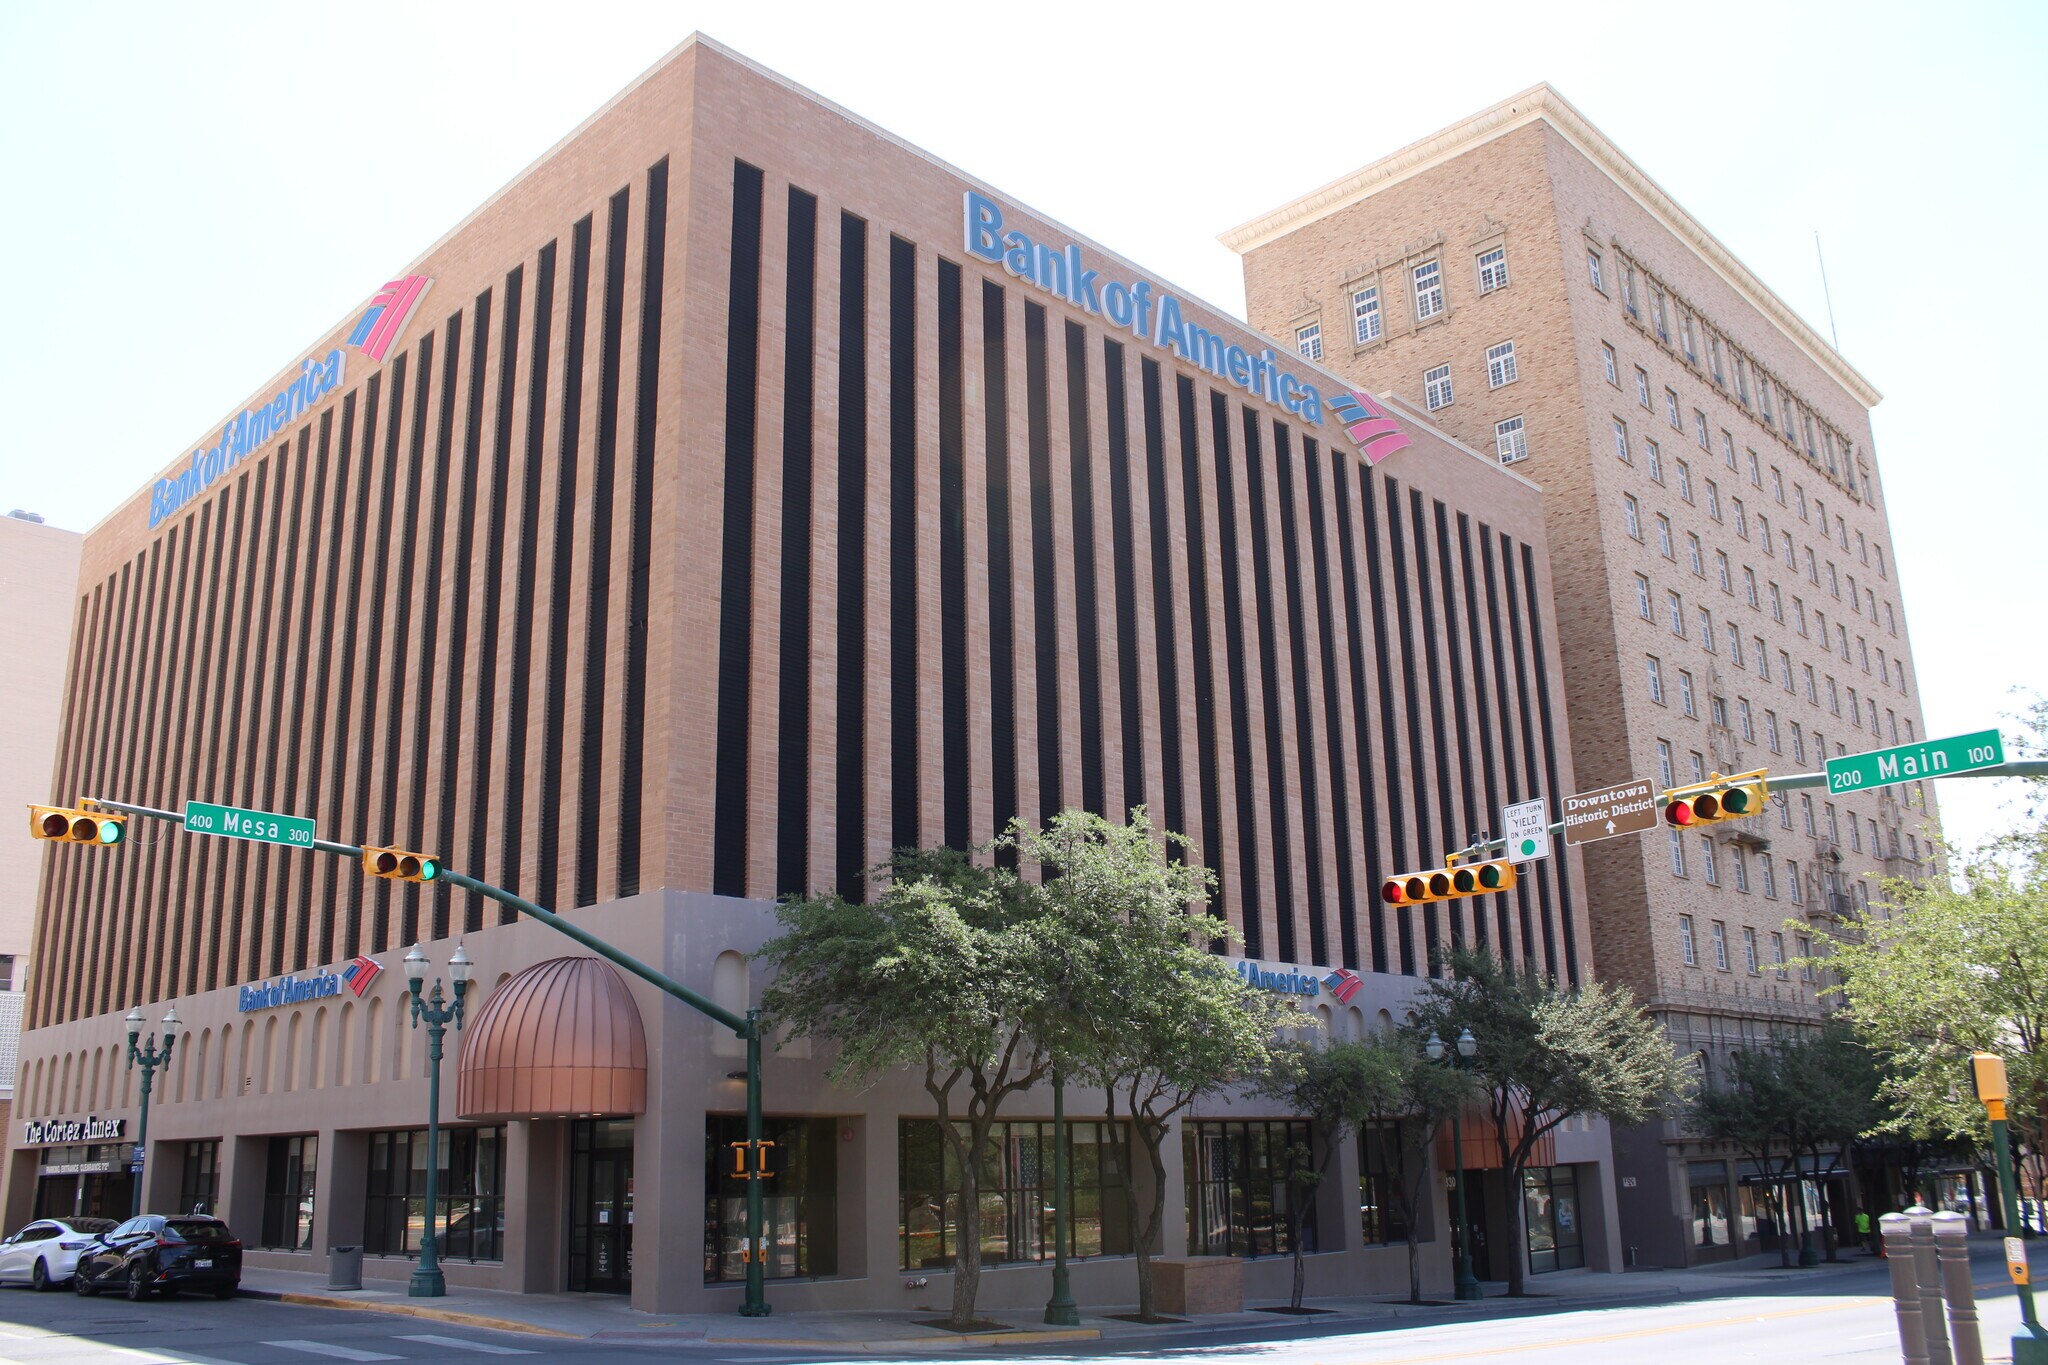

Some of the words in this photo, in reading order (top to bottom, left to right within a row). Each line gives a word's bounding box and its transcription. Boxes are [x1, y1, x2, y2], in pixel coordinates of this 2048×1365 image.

[963, 190, 1101, 316] Bank
[1101, 280, 1152, 340] of
[1154, 294, 1324, 428] America
[148, 449, 206, 530] Bank
[204, 420, 237, 486] of
[228, 349, 346, 466] America
[1832, 769, 1862, 789] 200
[1877, 748, 1949, 780] Main
[1967, 745, 1995, 764] 100
[1506, 808, 1521, 818] LEFT
[1526, 804, 1542, 813] TURN
[1566, 808, 1609, 827] Historic
[1611, 798, 1654, 817] District
[1567, 785, 1648, 811] Downtown
[189, 814, 213, 829] 400
[223, 811, 279, 839] Mesa
[288, 828, 310, 843] 300
[1510, 831, 1520, 840] ON
[1522, 826, 1543, 836] GREEN
[239, 981, 272, 1012] Bank
[270, 977, 286, 1007] of
[284, 969, 342, 1004] America
[1249, 962, 1320, 996] America
[24, 1121, 41, 1144] The
[44, 1119, 80, 1143] Cortez
[82, 1116, 121, 1140] Annex
